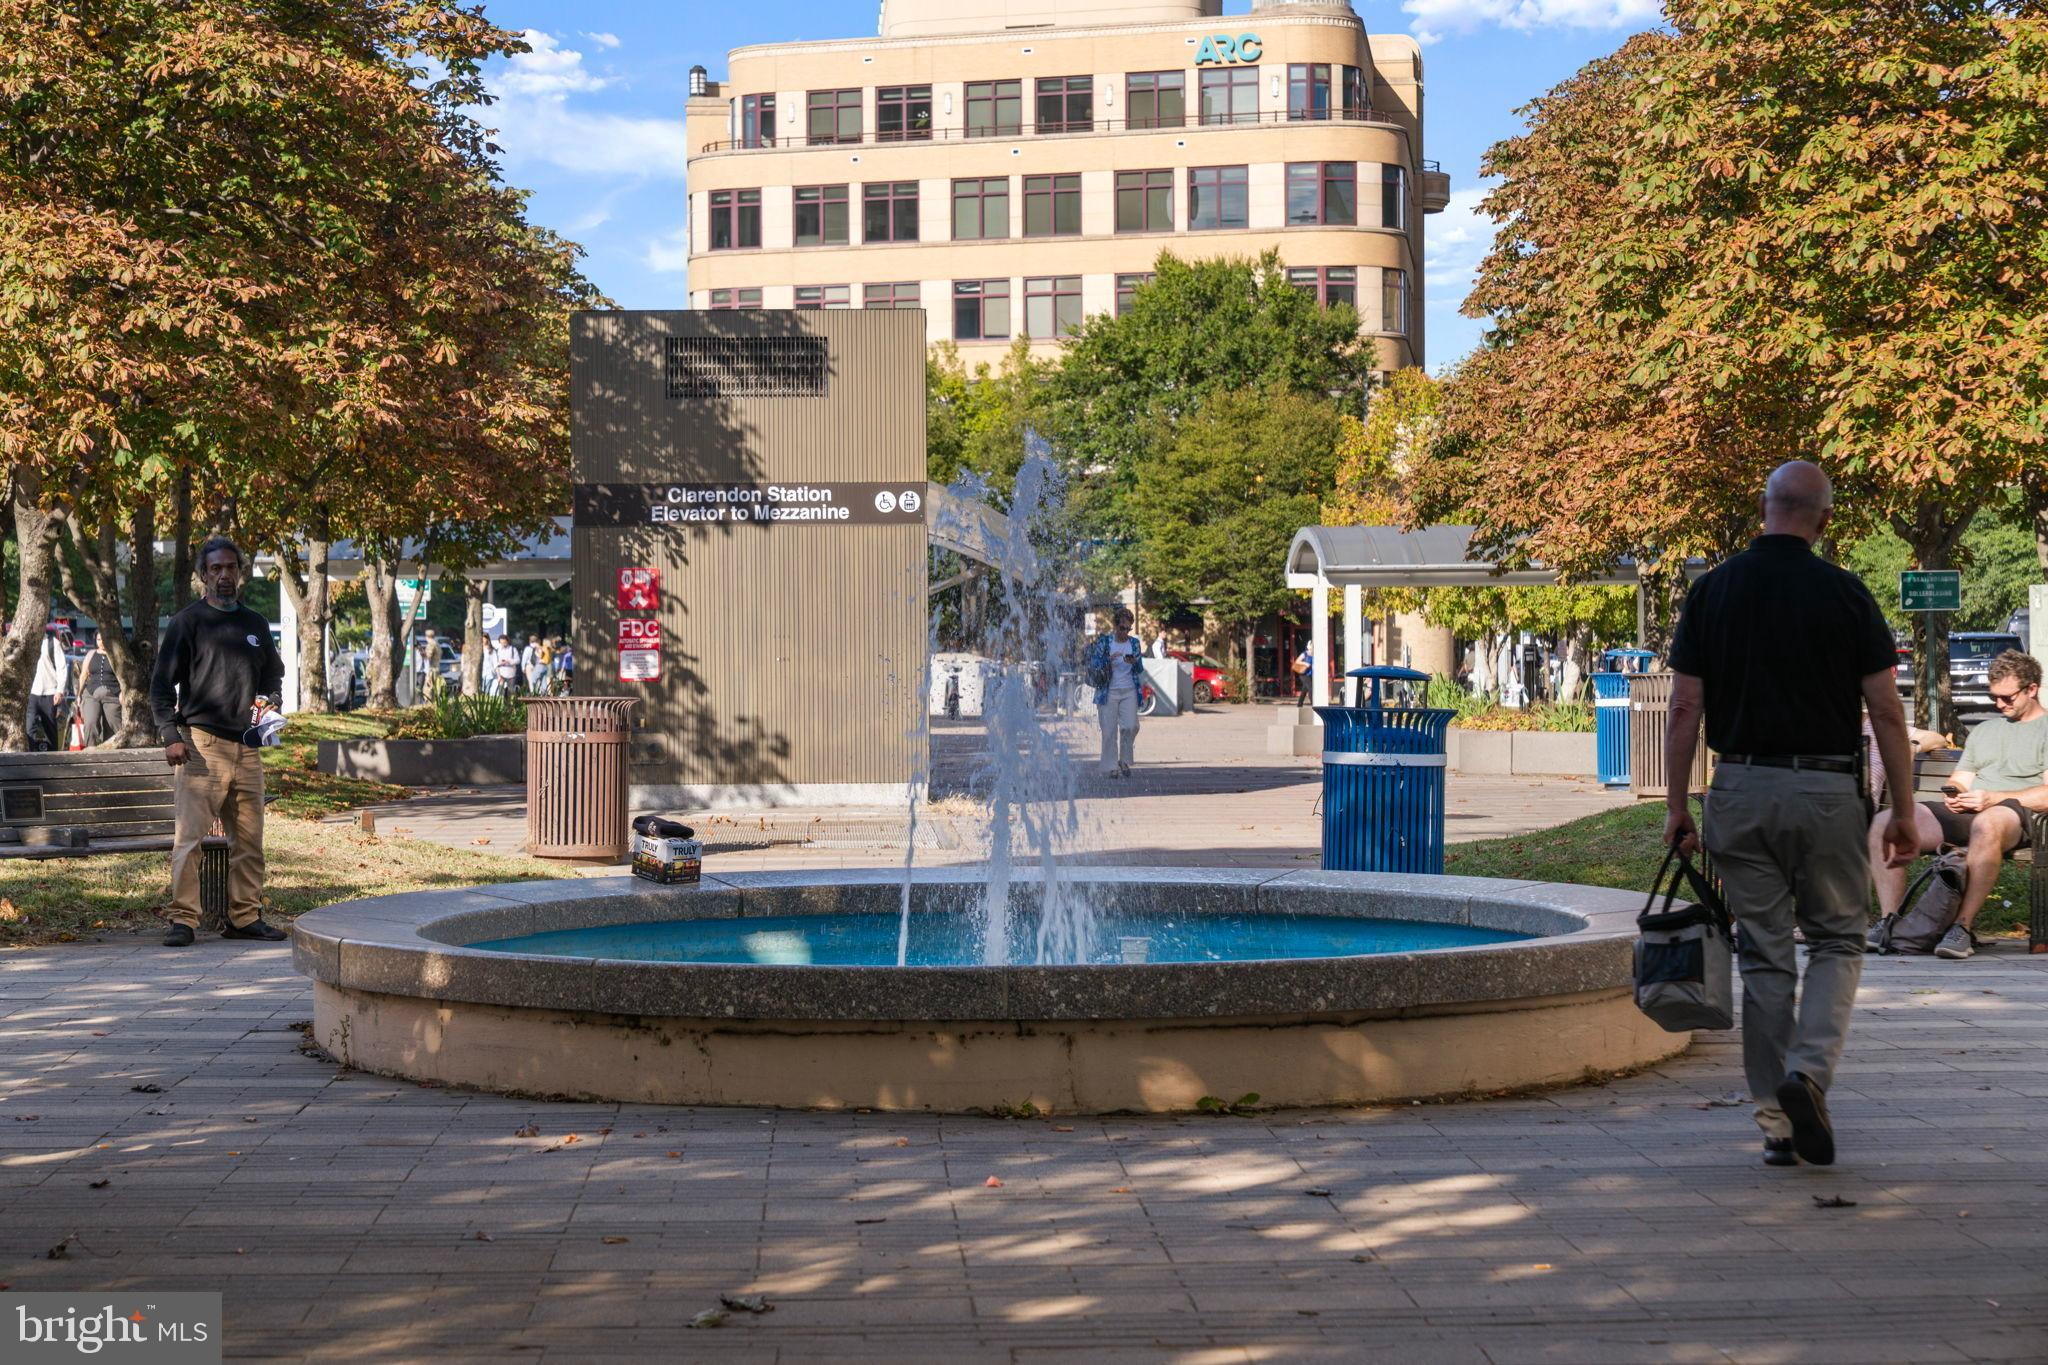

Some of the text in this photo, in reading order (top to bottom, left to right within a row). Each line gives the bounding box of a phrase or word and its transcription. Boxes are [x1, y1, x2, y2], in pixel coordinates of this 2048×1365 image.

[1195, 32, 1263, 65] ARC
[667, 486, 832, 504] Clarendon Station
[651, 504, 850, 521] Elevator to Mezzanine
[620, 621, 659, 637] FDC
[641, 839, 659, 853] TRULY
[673, 844, 698, 856] TRULY
